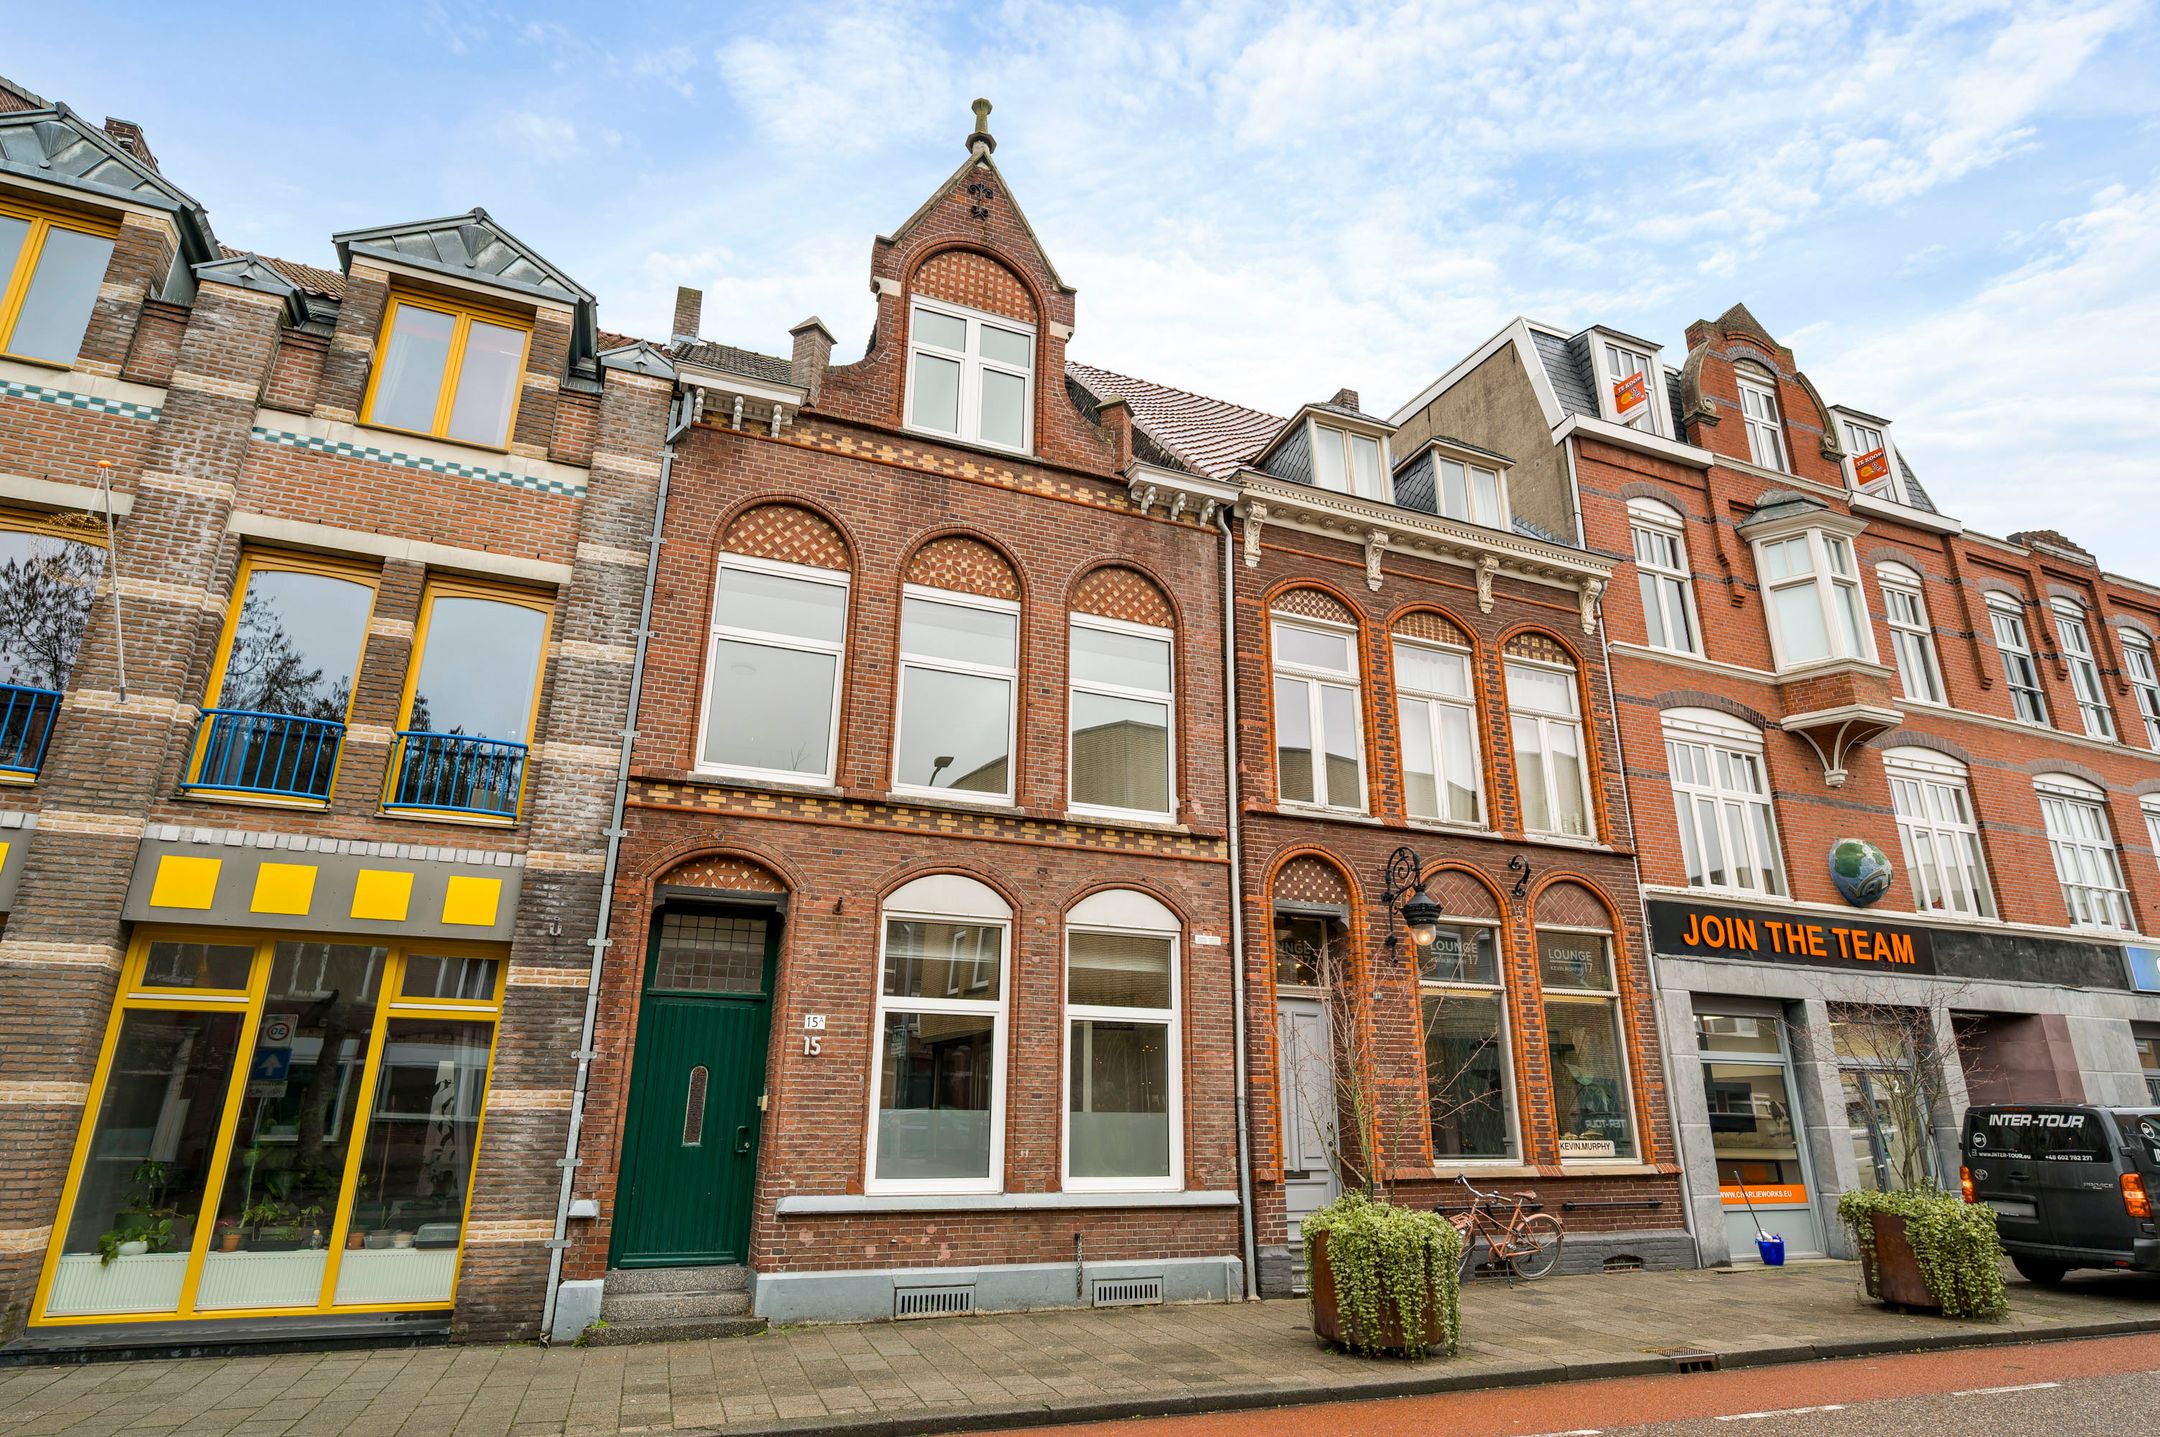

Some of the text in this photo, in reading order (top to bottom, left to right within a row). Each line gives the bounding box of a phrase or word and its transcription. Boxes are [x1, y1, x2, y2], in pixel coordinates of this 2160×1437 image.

[1683, 914, 1915, 964] JOIN THE TEAM
[1430, 940, 1478, 954] LOUNGE
[1548, 948, 1592, 961] LOUNGE
[803, 1036, 821, 1055] 15
[1989, 1114, 2084, 1128] INTER-TOUR
[1560, 1142, 1611, 1150] KEVIN.MURPHY
